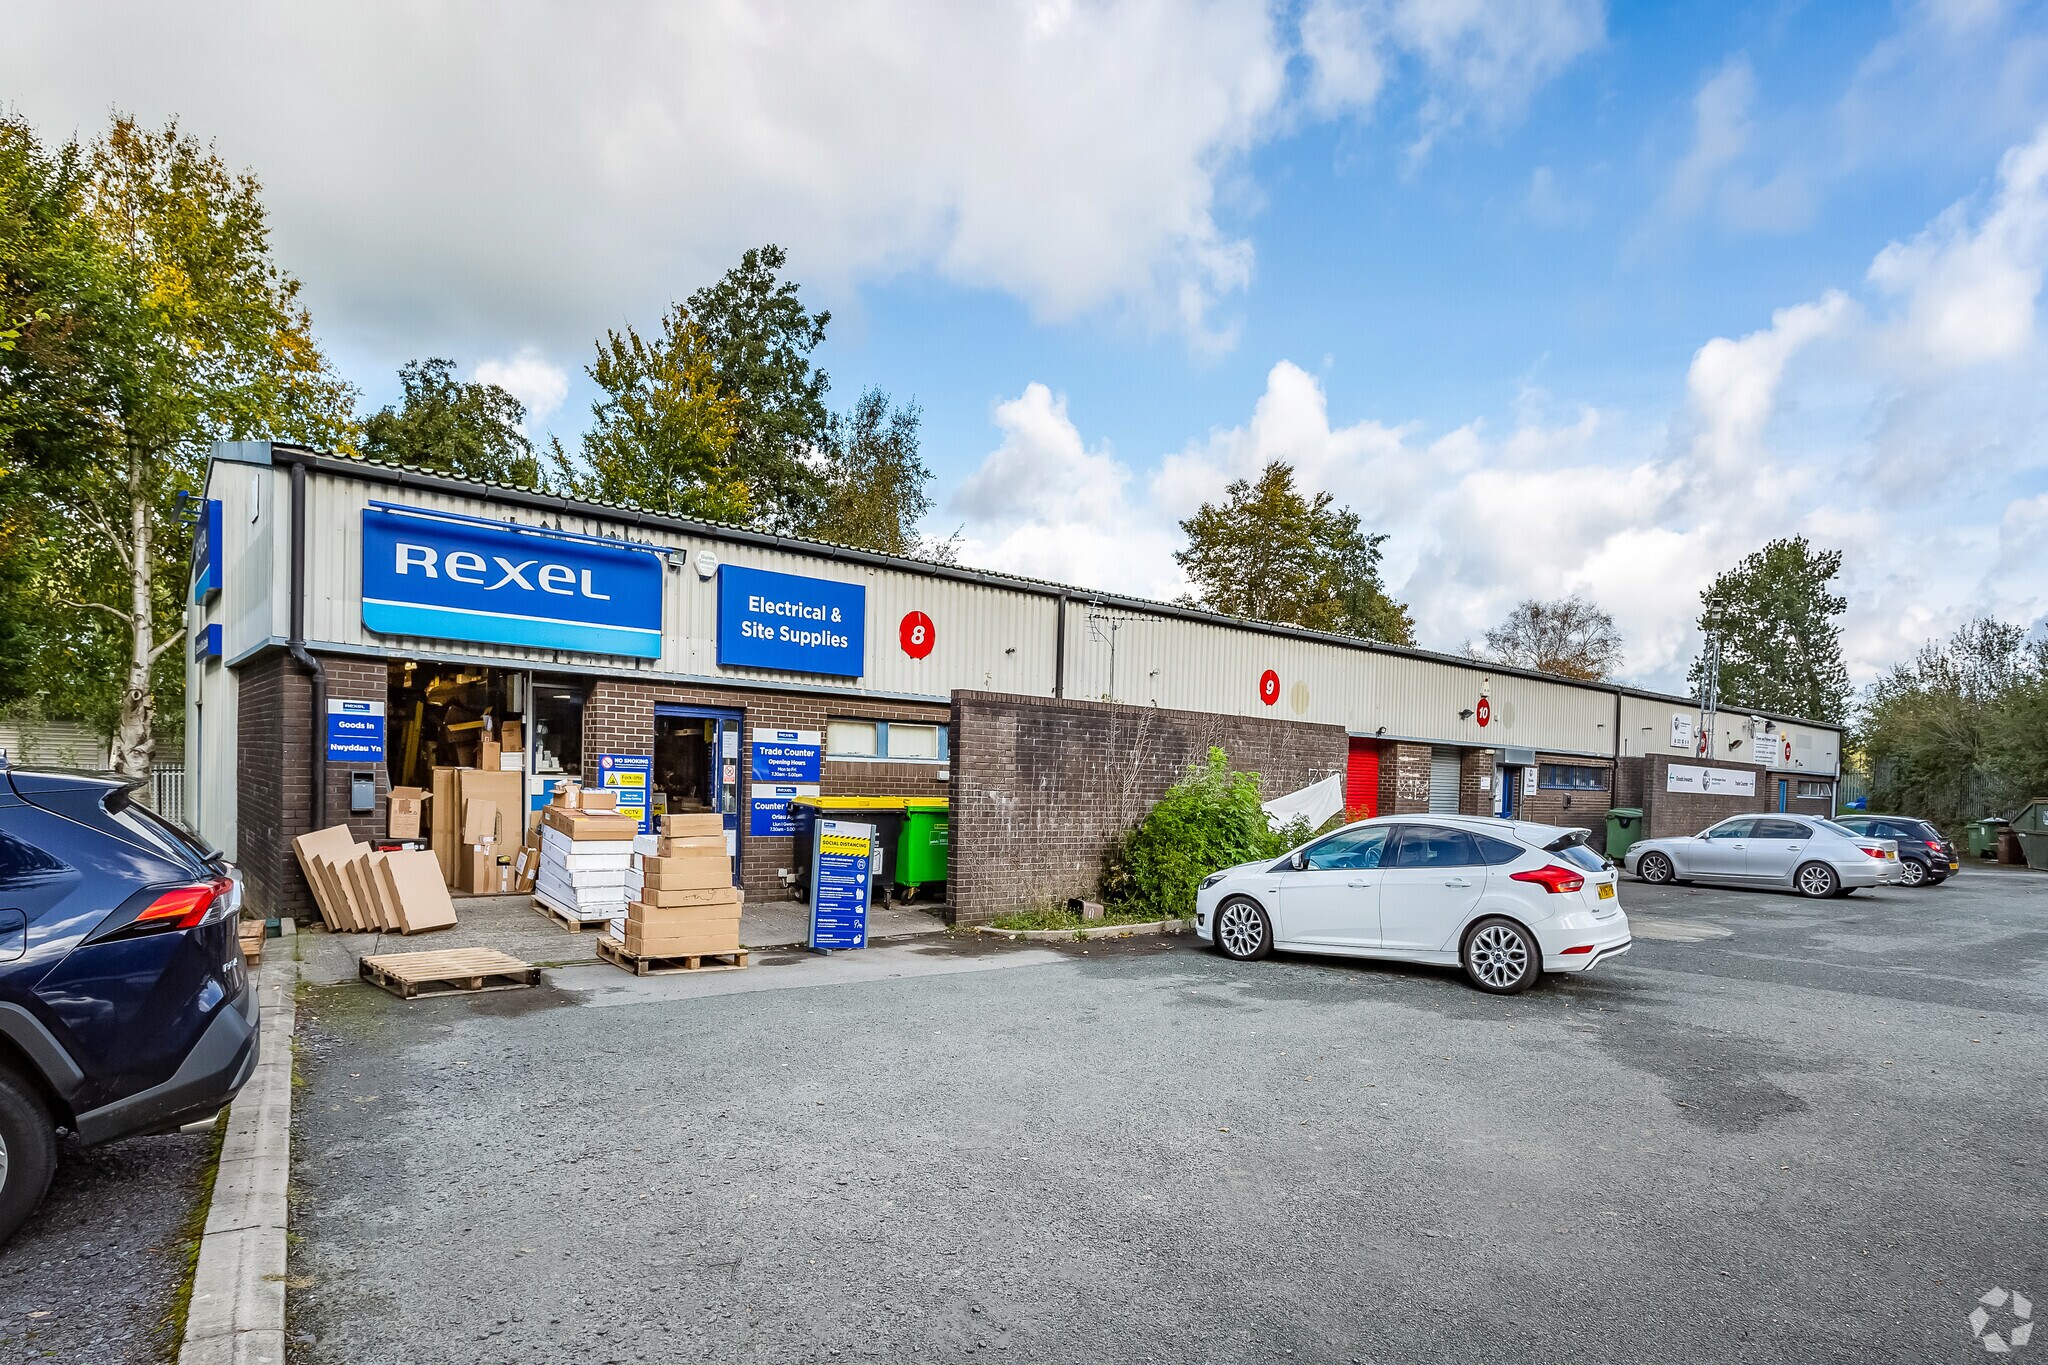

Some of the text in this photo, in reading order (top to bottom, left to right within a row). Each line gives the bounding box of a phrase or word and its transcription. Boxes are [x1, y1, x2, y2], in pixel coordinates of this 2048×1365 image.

[748, 595, 842, 623] Electrical &
[741, 620, 849, 648] Site Supplies
[910, 625, 926, 645] 8
[1266, 679, 1275, 695] 9
[1479, 706, 1489, 719] 10
[338, 721, 375, 730] Goods In
[330, 743, 382, 753] Nwyddau Yn
[759, 746, 815, 757] Trade Counter
[768, 758, 790, 767] Opening
[754, 802, 785, 810] Counter
